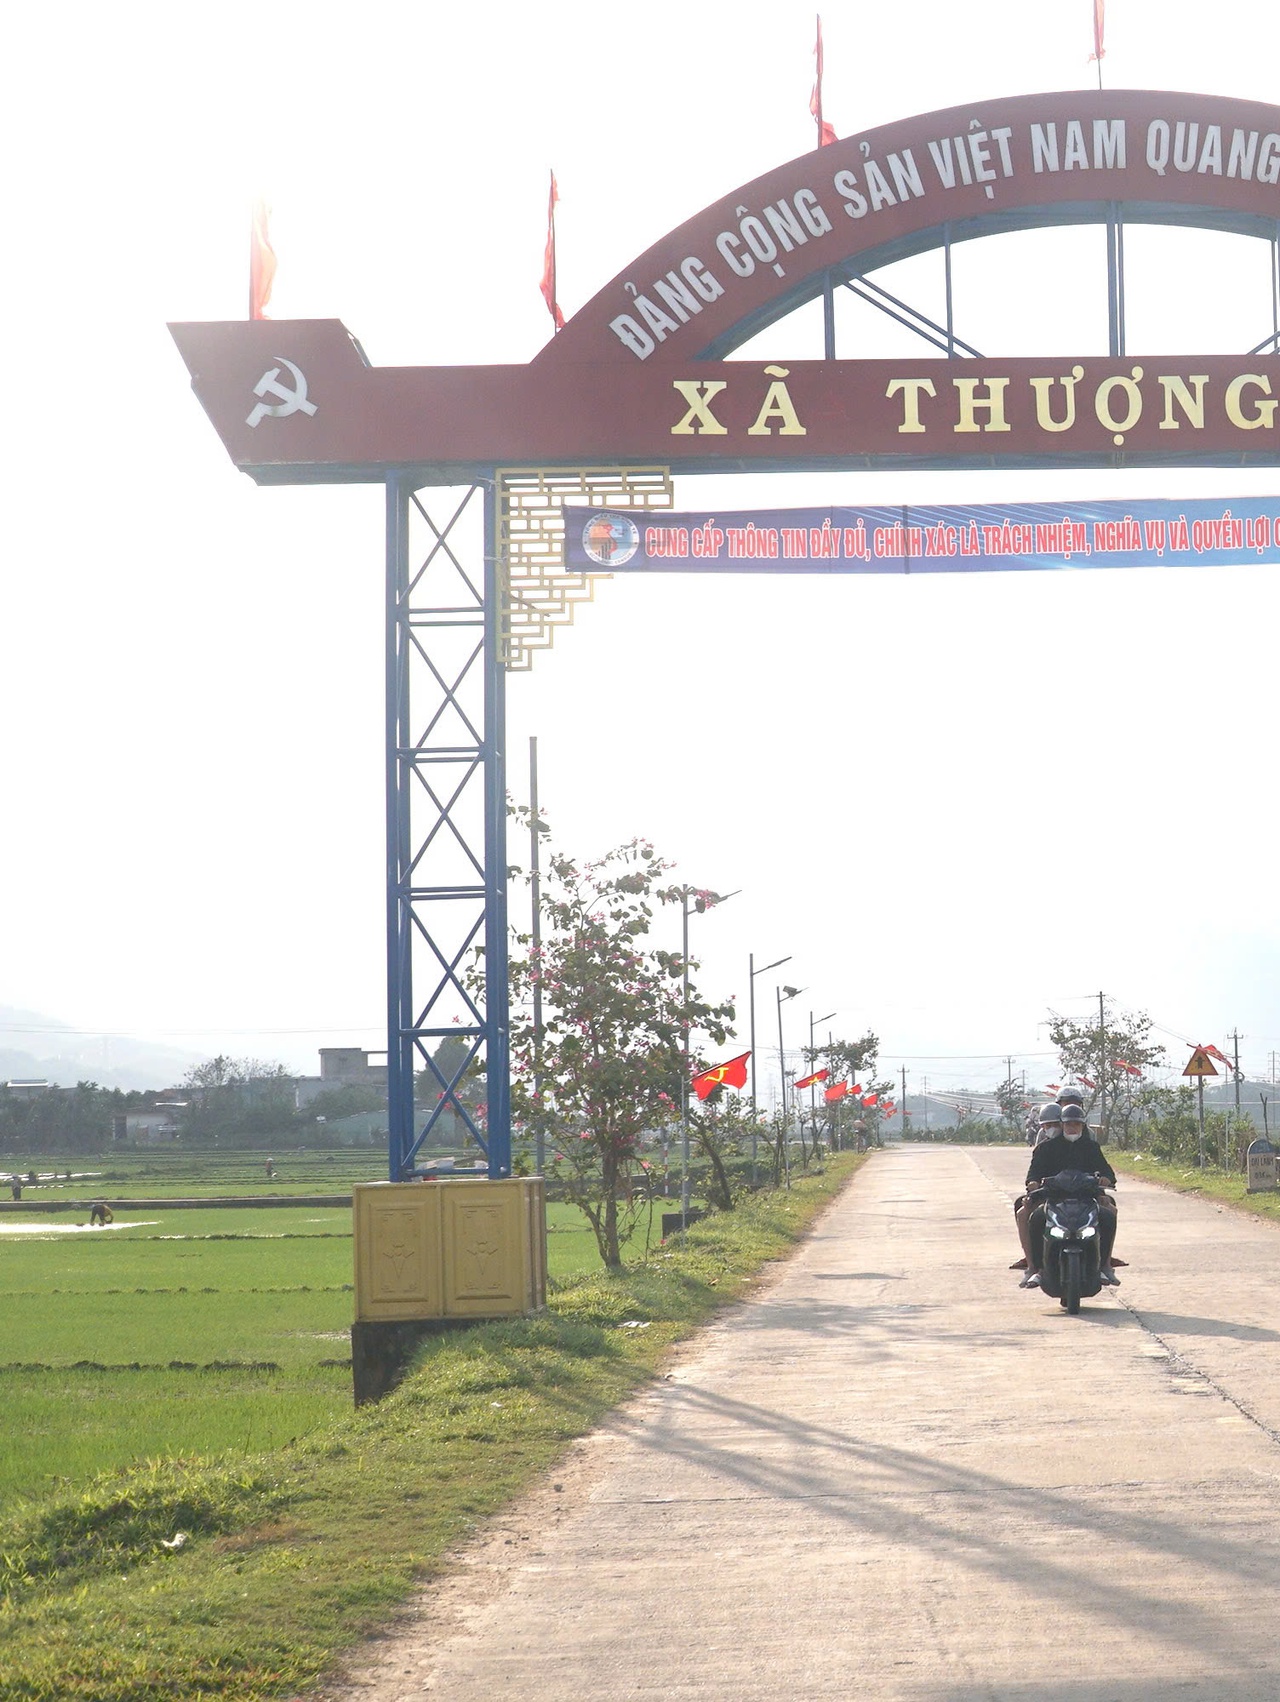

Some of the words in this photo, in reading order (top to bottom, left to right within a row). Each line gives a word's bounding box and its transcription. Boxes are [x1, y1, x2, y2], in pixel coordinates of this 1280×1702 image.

[609, 256, 725, 361] ĐẢNG
[716, 189, 833, 278] CỘNG
[834, 142, 925, 219] SẢN
[928, 119, 1014, 199] VIỆT
[1030, 119, 1126, 173] NAM
[670, 365, 807, 435] XÃ
[885, 365, 1279, 446] THƯỢNG
[646, 527, 689, 557] CUNG
[692, 519, 724, 558] CẤP
[726, 522, 778, 558] THÔNG
[780, 528, 807, 558] TIN
[810, 518, 841, 558] ĐẦY
[844, 518, 871, 562] ĐỦ,
[874, 521, 922, 557] CHÍNH
[925, 520, 957, 557] XÁC
[960, 519, 980, 556] LÀ
[983, 518, 1033, 556] TRÁCH
[1036, 517, 1091, 559] NHIỆM,
[1094, 516, 1142, 552] NGHĨA
[1144, 519, 1166, 556] VỤ
[1168, 515, 1190, 552] VÀ
[1192, 509, 1242, 554] QUYỀN
[1246, 514, 1271, 554] LỢI
